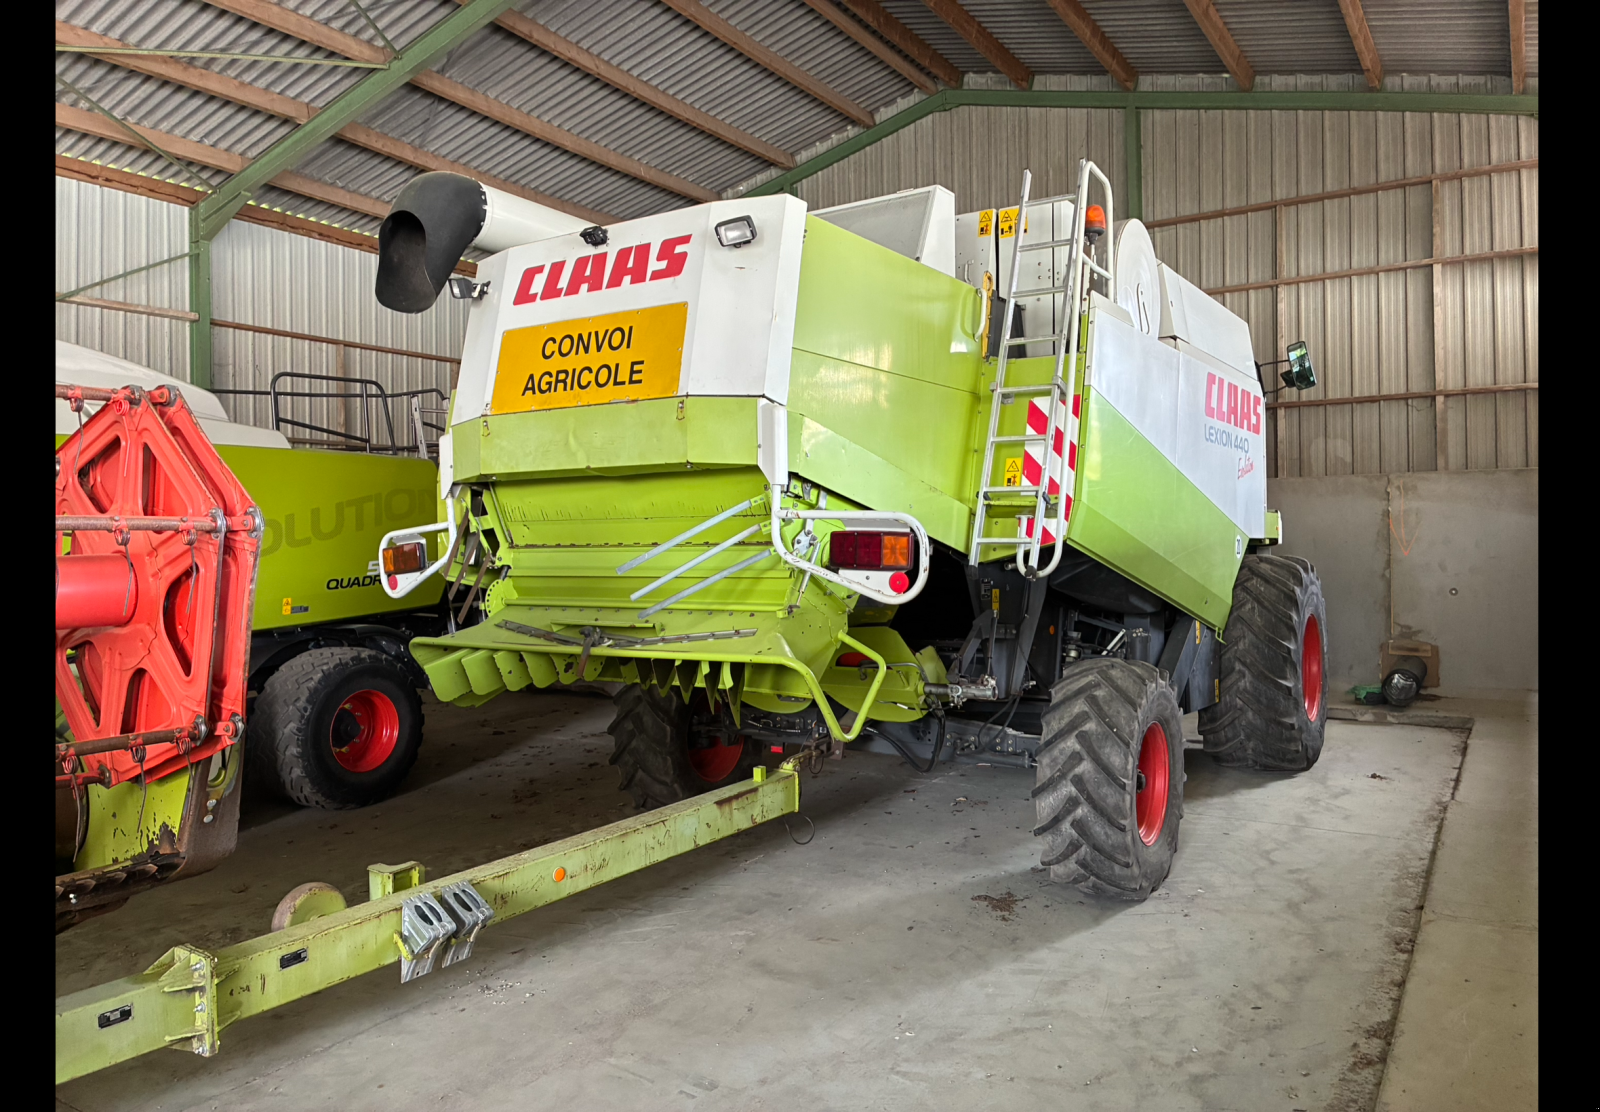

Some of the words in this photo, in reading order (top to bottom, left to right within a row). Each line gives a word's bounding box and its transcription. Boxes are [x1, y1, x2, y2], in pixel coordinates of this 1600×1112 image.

[513, 234, 693, 306] CLAAS
[541, 325, 633, 360] CONVOI
[521, 360, 645, 397] AGRICOLE
[1204, 371, 1261, 436] CLAAS
[1204, 423, 1233, 449] LEXION
[1234, 434, 1250, 454] 440
